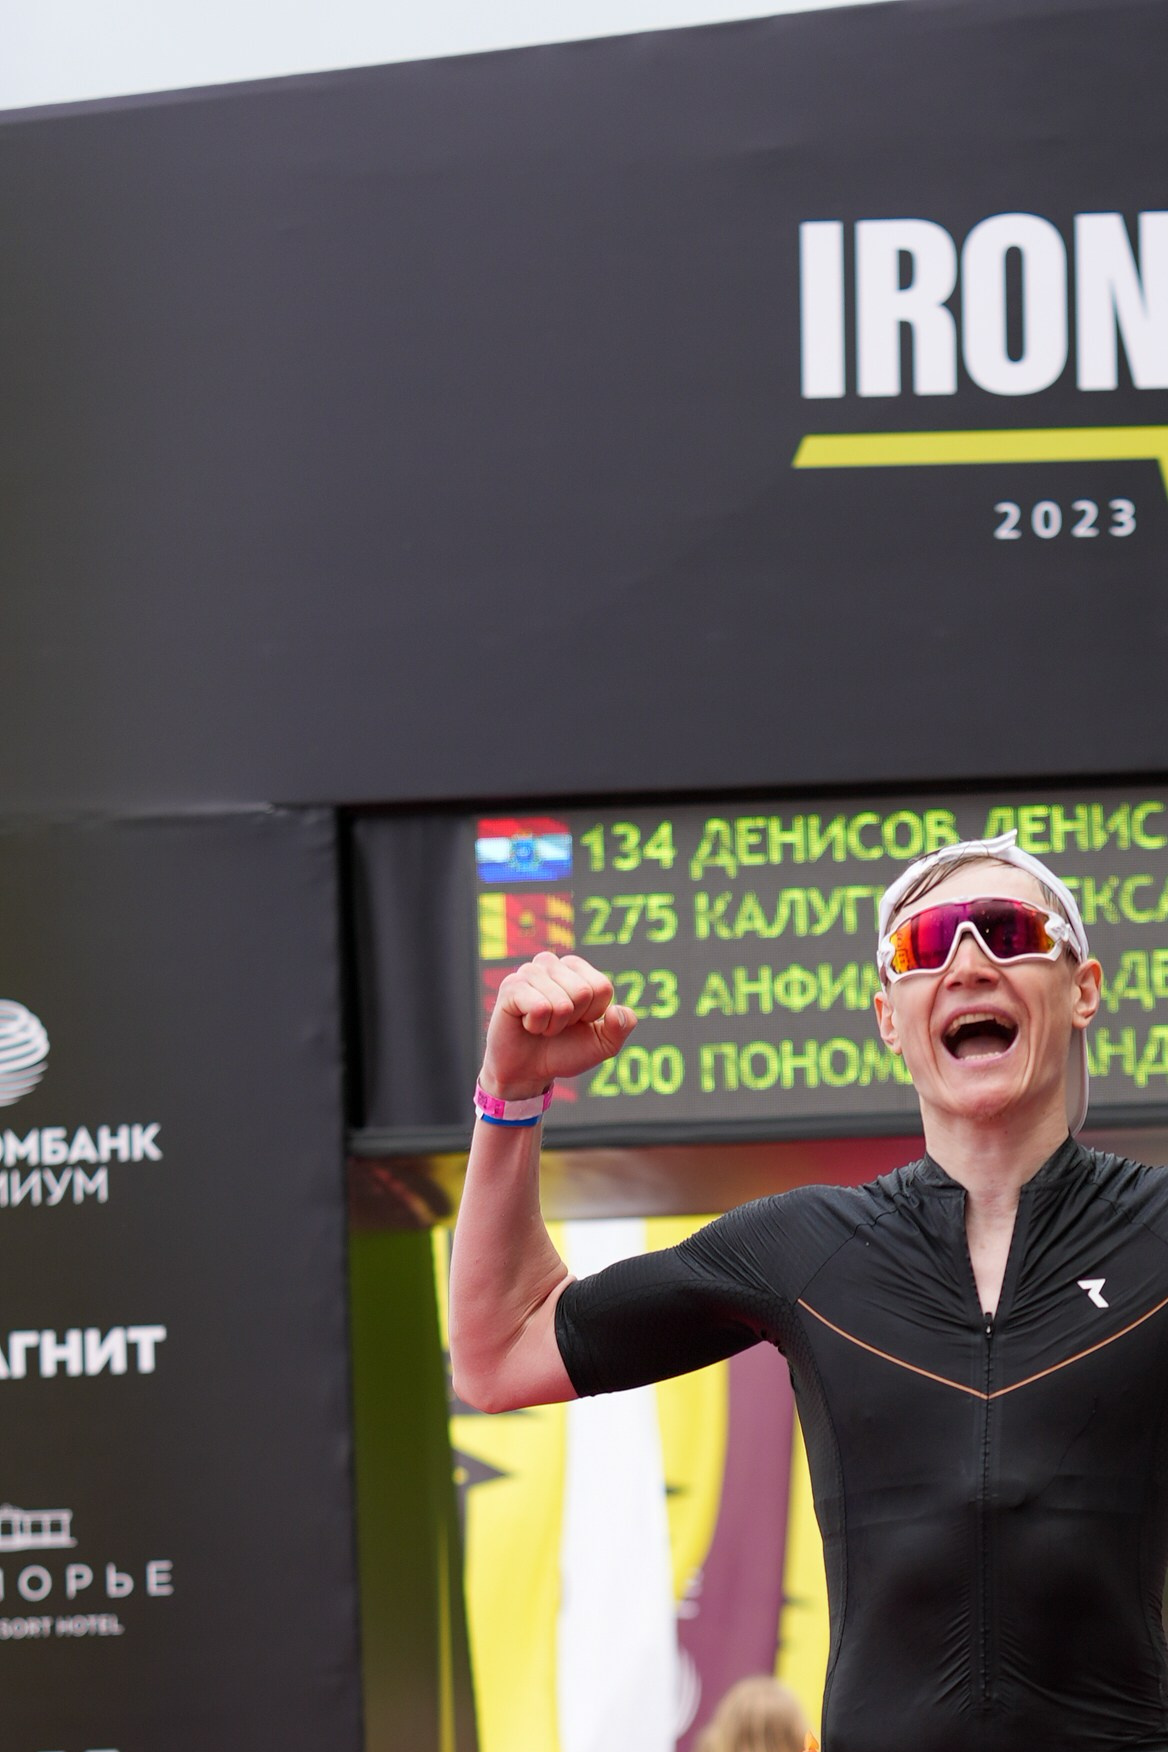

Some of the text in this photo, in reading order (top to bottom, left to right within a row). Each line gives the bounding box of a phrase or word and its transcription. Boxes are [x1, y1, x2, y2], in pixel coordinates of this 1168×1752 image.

[993, 499, 1138, 539] 2023
[580, 820, 676, 871] 134
[690, 808, 960, 881] ДЕНИСОВ
[581, 893, 679, 945] 275
[694, 884, 886, 940] КАЛУГ
[602, 968, 680, 1019] 23
[588, 1045, 685, 1097] 200
[0, 1122, 163, 1167] МБАНК
[0, 1165, 109, 1208] ИУМ
[0, 1559, 175, 1602] ОРЬЕ
[55, 1613, 126, 1639] HOTEL
